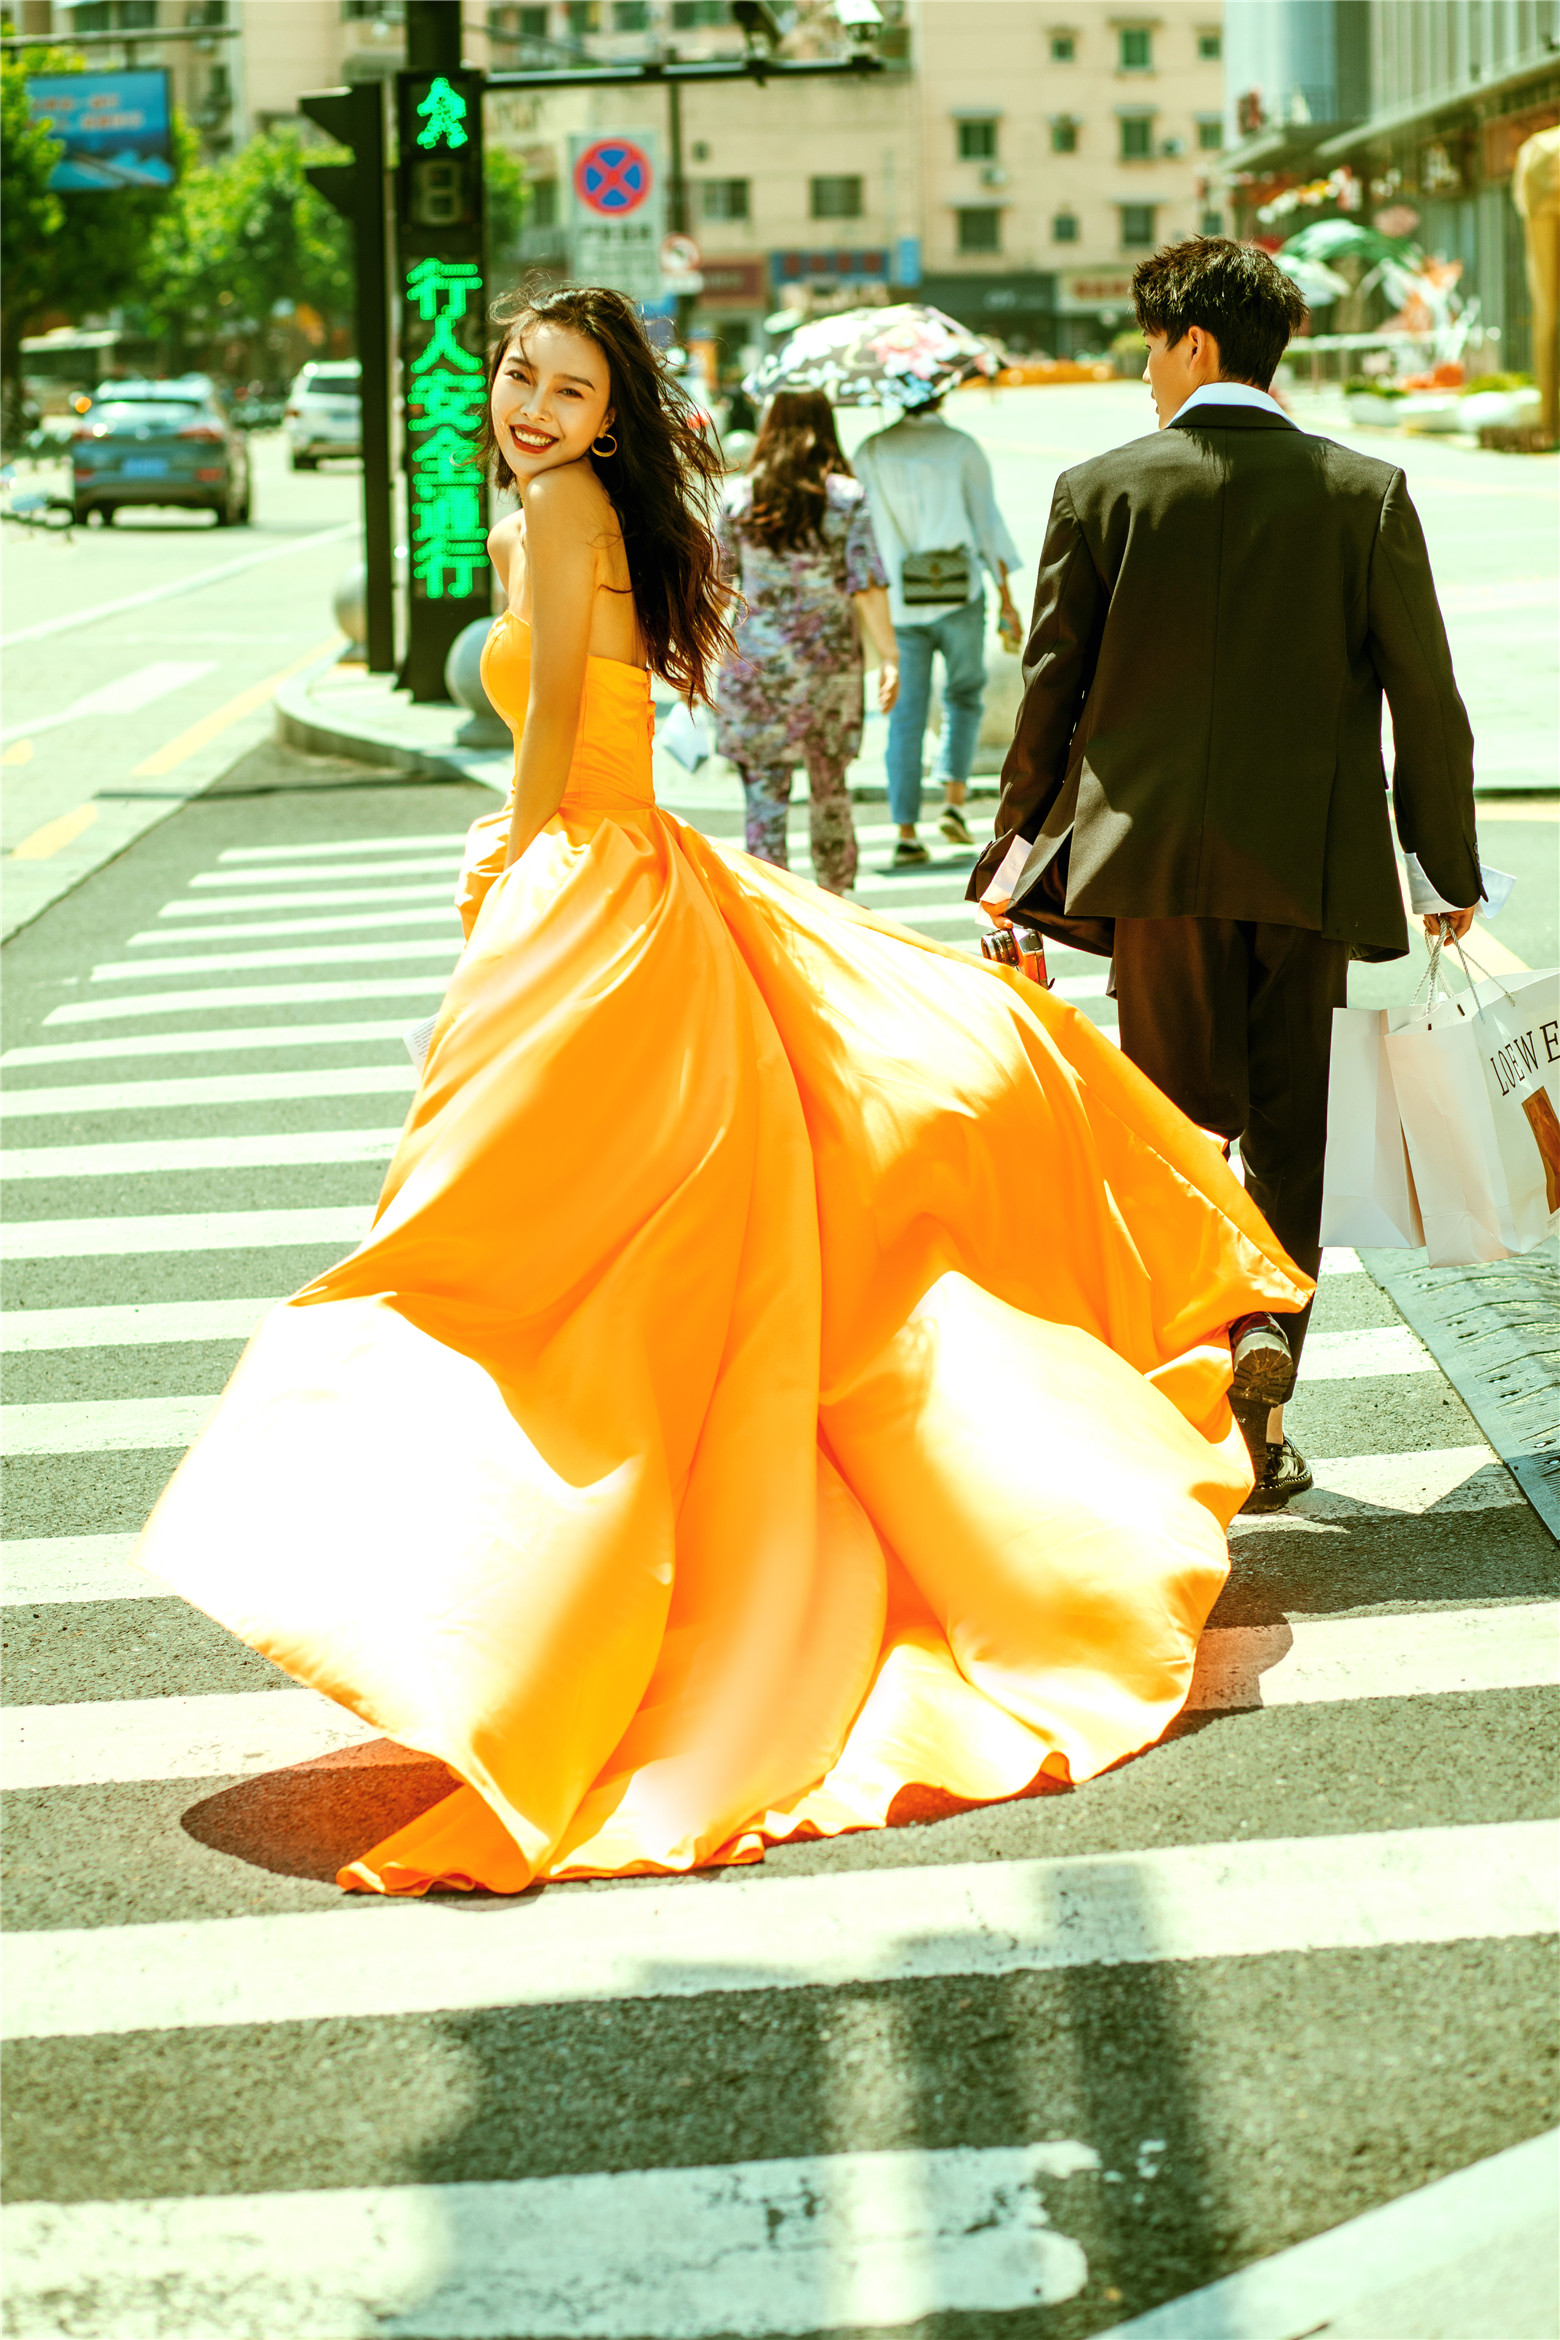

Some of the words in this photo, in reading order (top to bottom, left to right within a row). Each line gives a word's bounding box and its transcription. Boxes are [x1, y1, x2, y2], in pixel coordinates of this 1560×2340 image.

[406, 258, 490, 599] 行人安全通行
[1490, 1020, 1560, 1096] LOEWE
